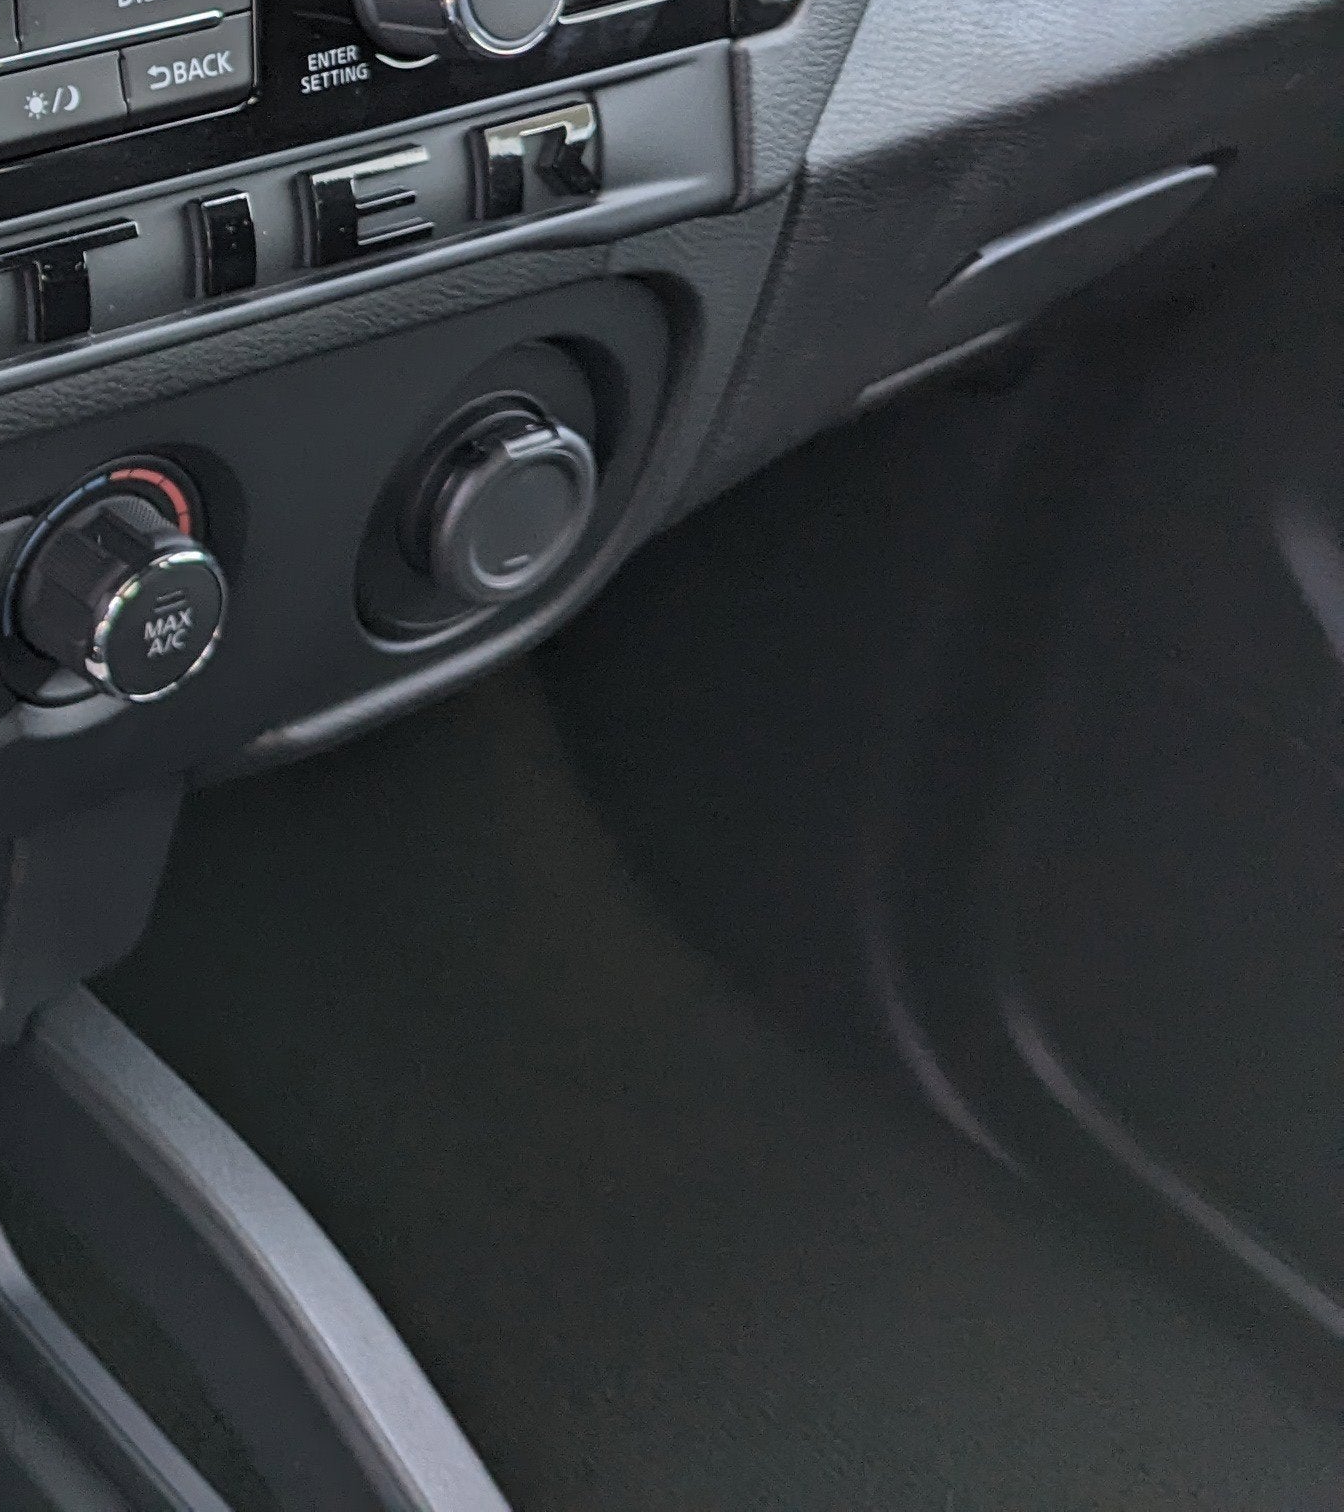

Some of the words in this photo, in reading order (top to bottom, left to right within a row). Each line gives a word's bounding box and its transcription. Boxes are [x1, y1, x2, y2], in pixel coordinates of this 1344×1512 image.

[173, 50, 233, 86] BACK
[307, 44, 360, 72] ENTER
[300, 62, 371, 95] SETTING
[143, 607, 194, 640] MAX
[147, 628, 187, 658] A/C
